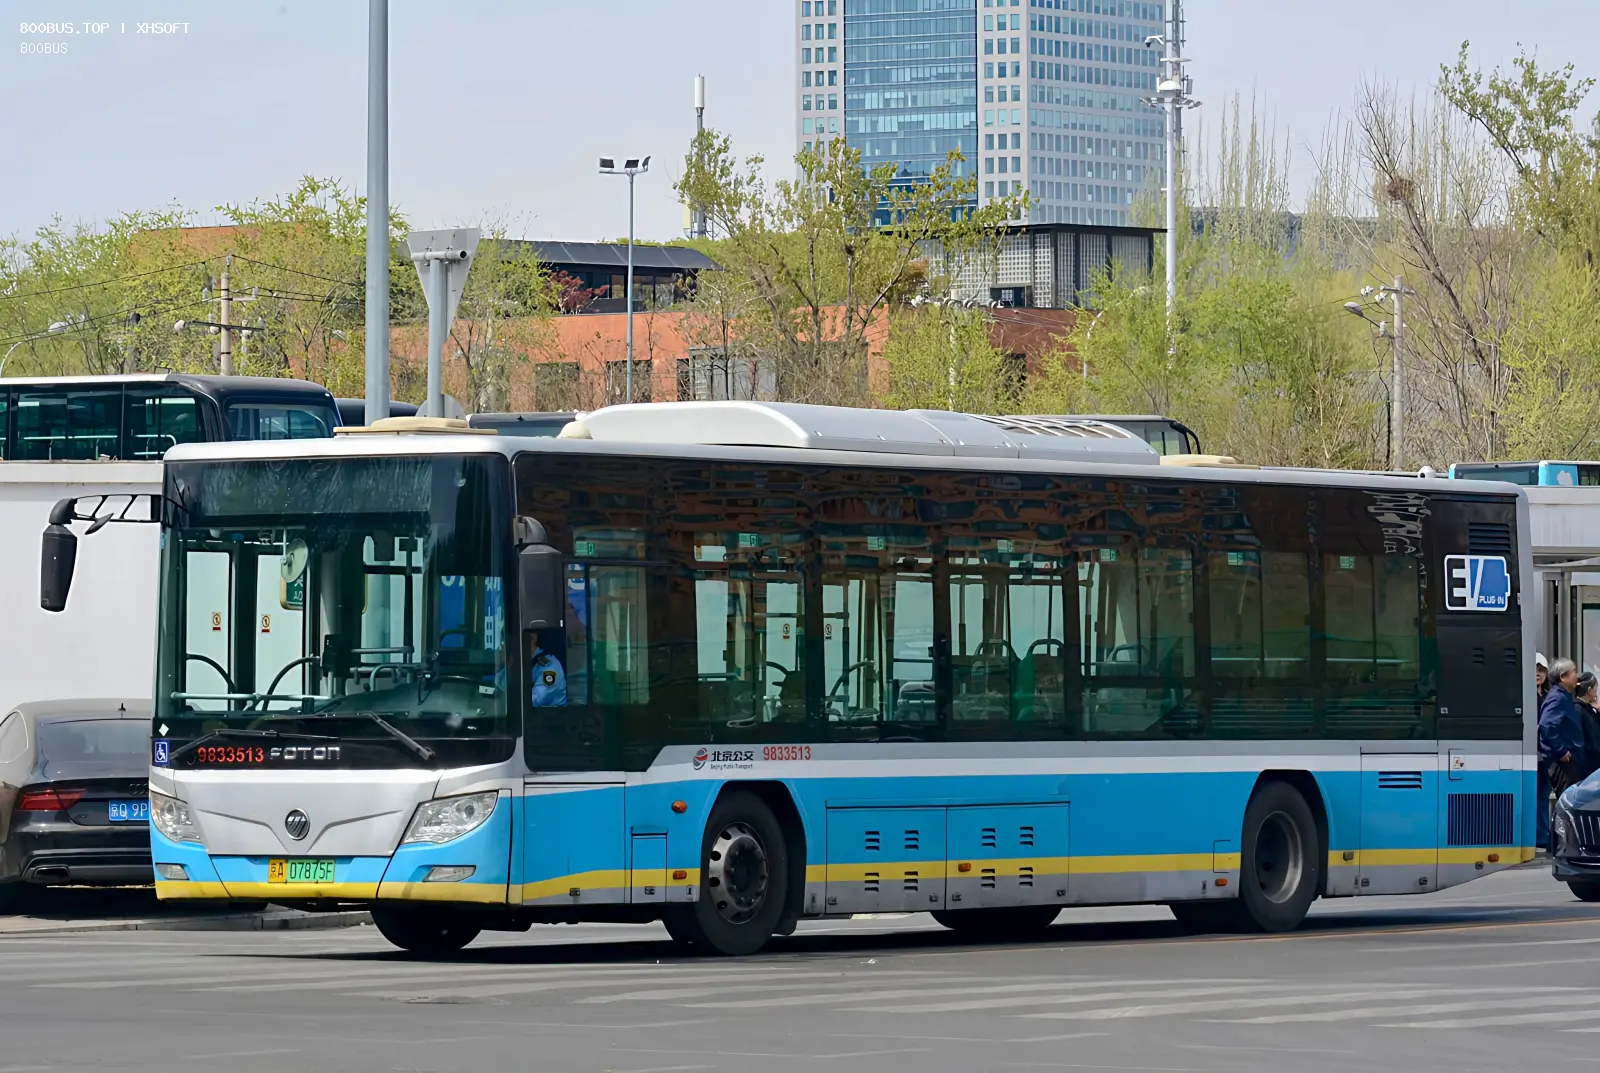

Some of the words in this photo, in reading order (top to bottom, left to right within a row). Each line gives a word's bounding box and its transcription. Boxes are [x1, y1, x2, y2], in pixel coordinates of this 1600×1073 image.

[197, 747, 265, 763] 9833513
[270, 747, 340, 760] FOTON
[711, 750, 754, 762] 北京公交
[763, 746, 811, 761] 9833513
